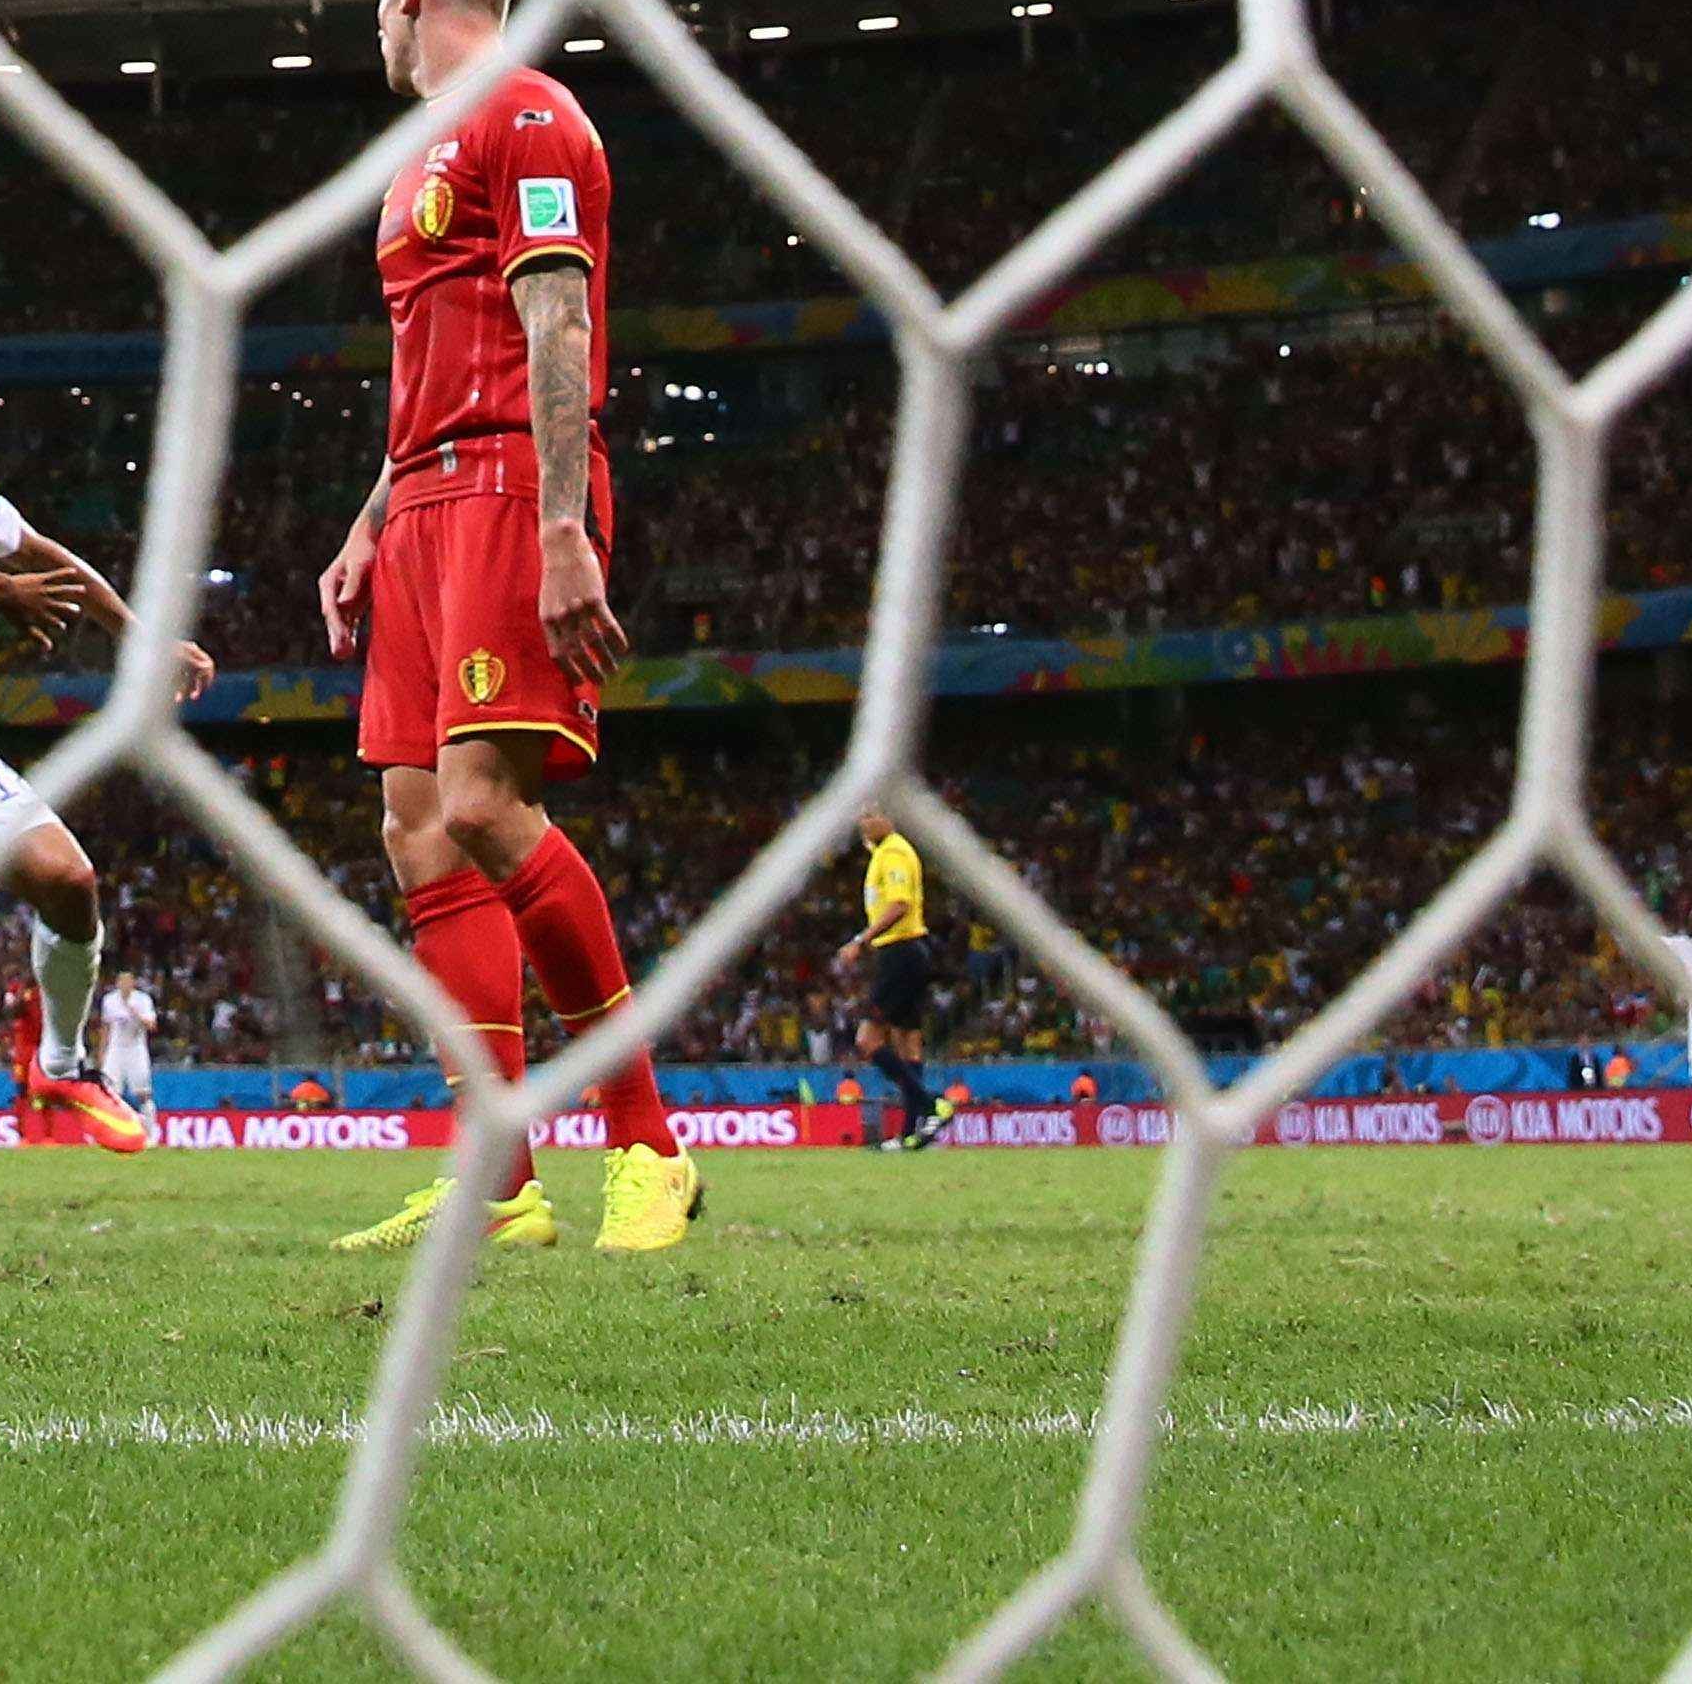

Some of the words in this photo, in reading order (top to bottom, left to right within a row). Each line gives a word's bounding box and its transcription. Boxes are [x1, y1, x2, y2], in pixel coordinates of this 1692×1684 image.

[167, 1115, 236, 1148] KIA
[243, 1115, 409, 1149] MOTORS
[665, 1109, 798, 1146] OTORS
[991, 1110, 1077, 1144] MOTORS
[1314, 1105, 1349, 1141] KIA
[1353, 1102, 1442, 1142] MOTORS
[1511, 1100, 1554, 1139] KIA
[1558, 1097, 1662, 1141] MOTORS
